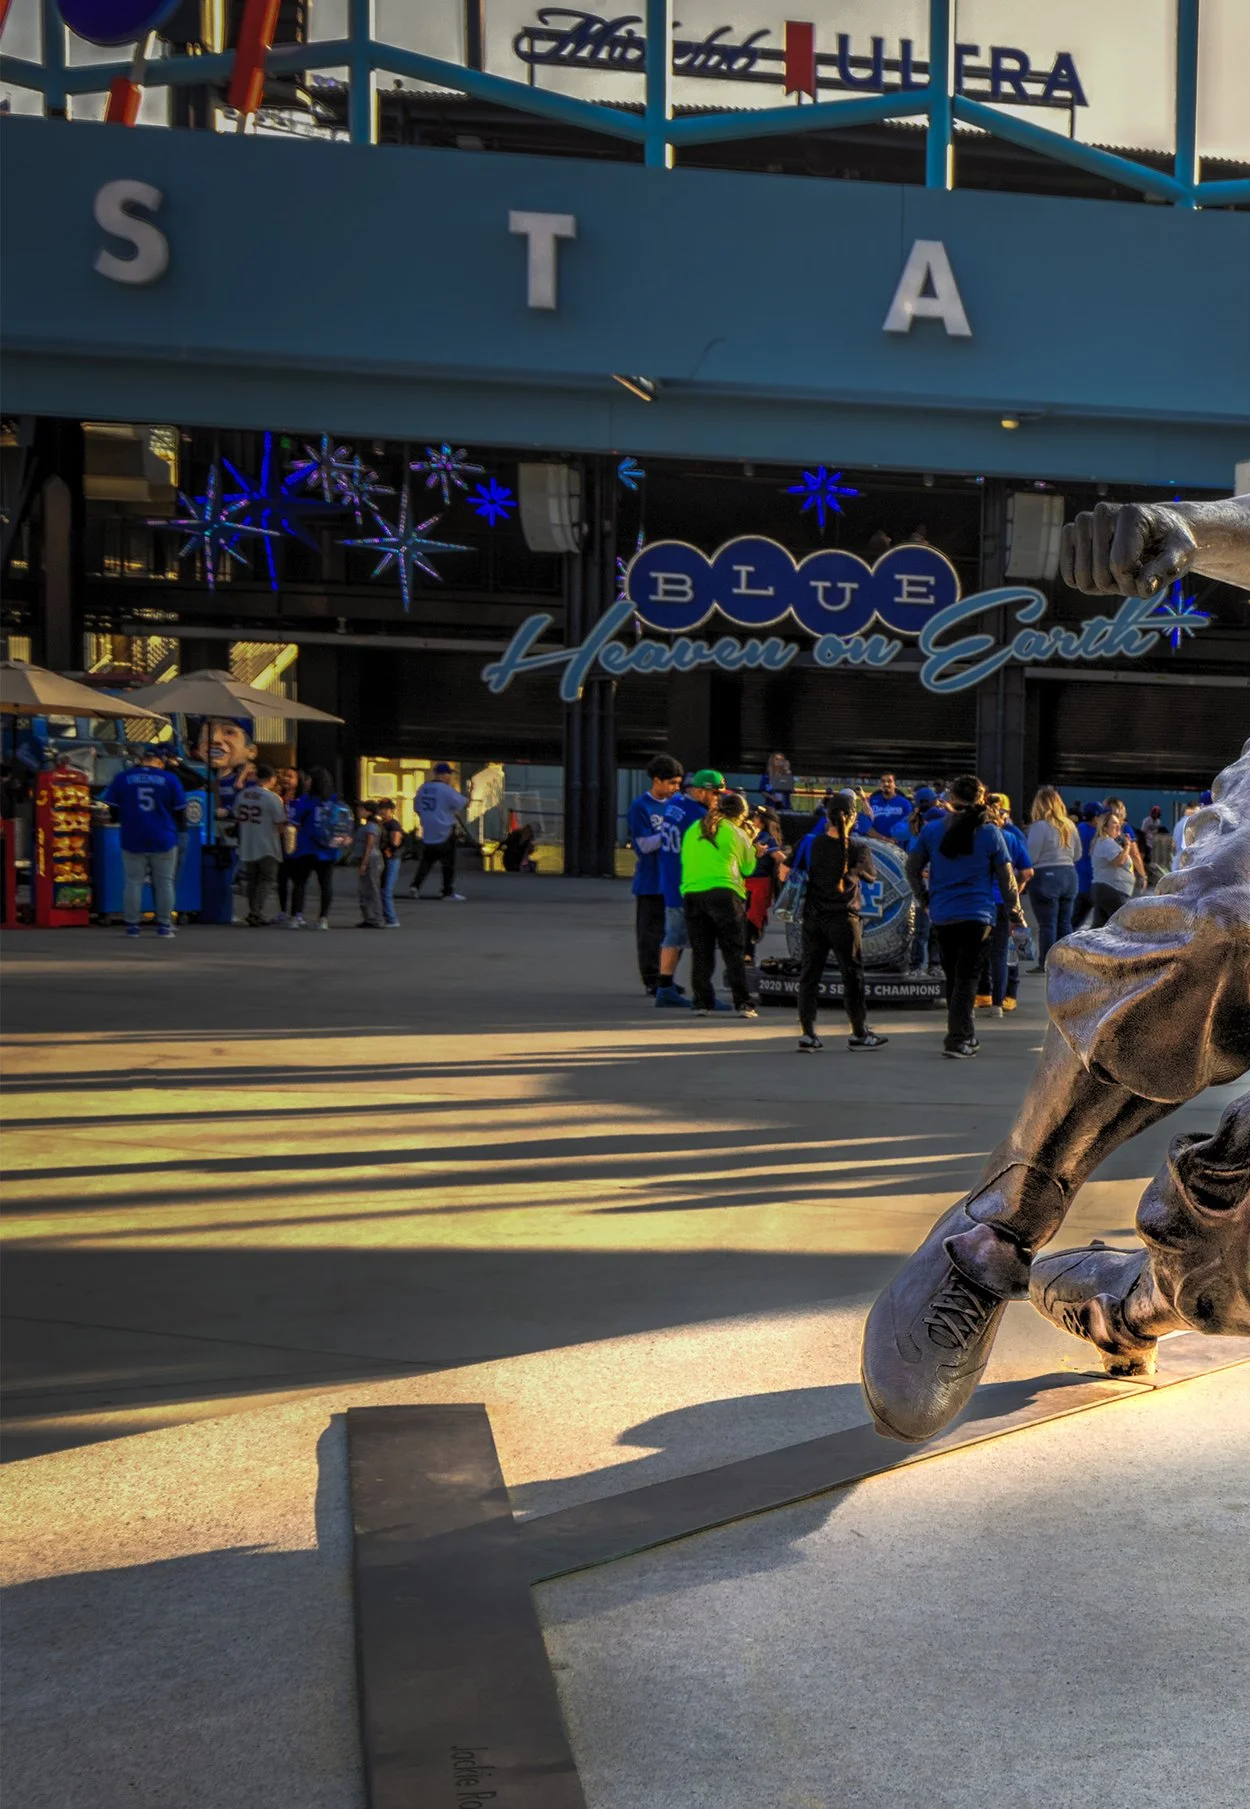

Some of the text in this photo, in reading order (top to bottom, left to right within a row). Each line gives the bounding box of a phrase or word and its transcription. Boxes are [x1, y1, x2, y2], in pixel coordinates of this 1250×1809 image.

[513, 8, 771, 75] Micelob
[649, 566, 935, 612] BLUE
[481, 585, 1210, 701] Heaven on Earth
[136, 787, 155, 812] 5
[759, 979, 782, 991] 2020
[784, 981, 827, 994] WOD
[874, 984, 941, 996] CHAMPIONS
[450, 1745, 496, 1787] Jackie
